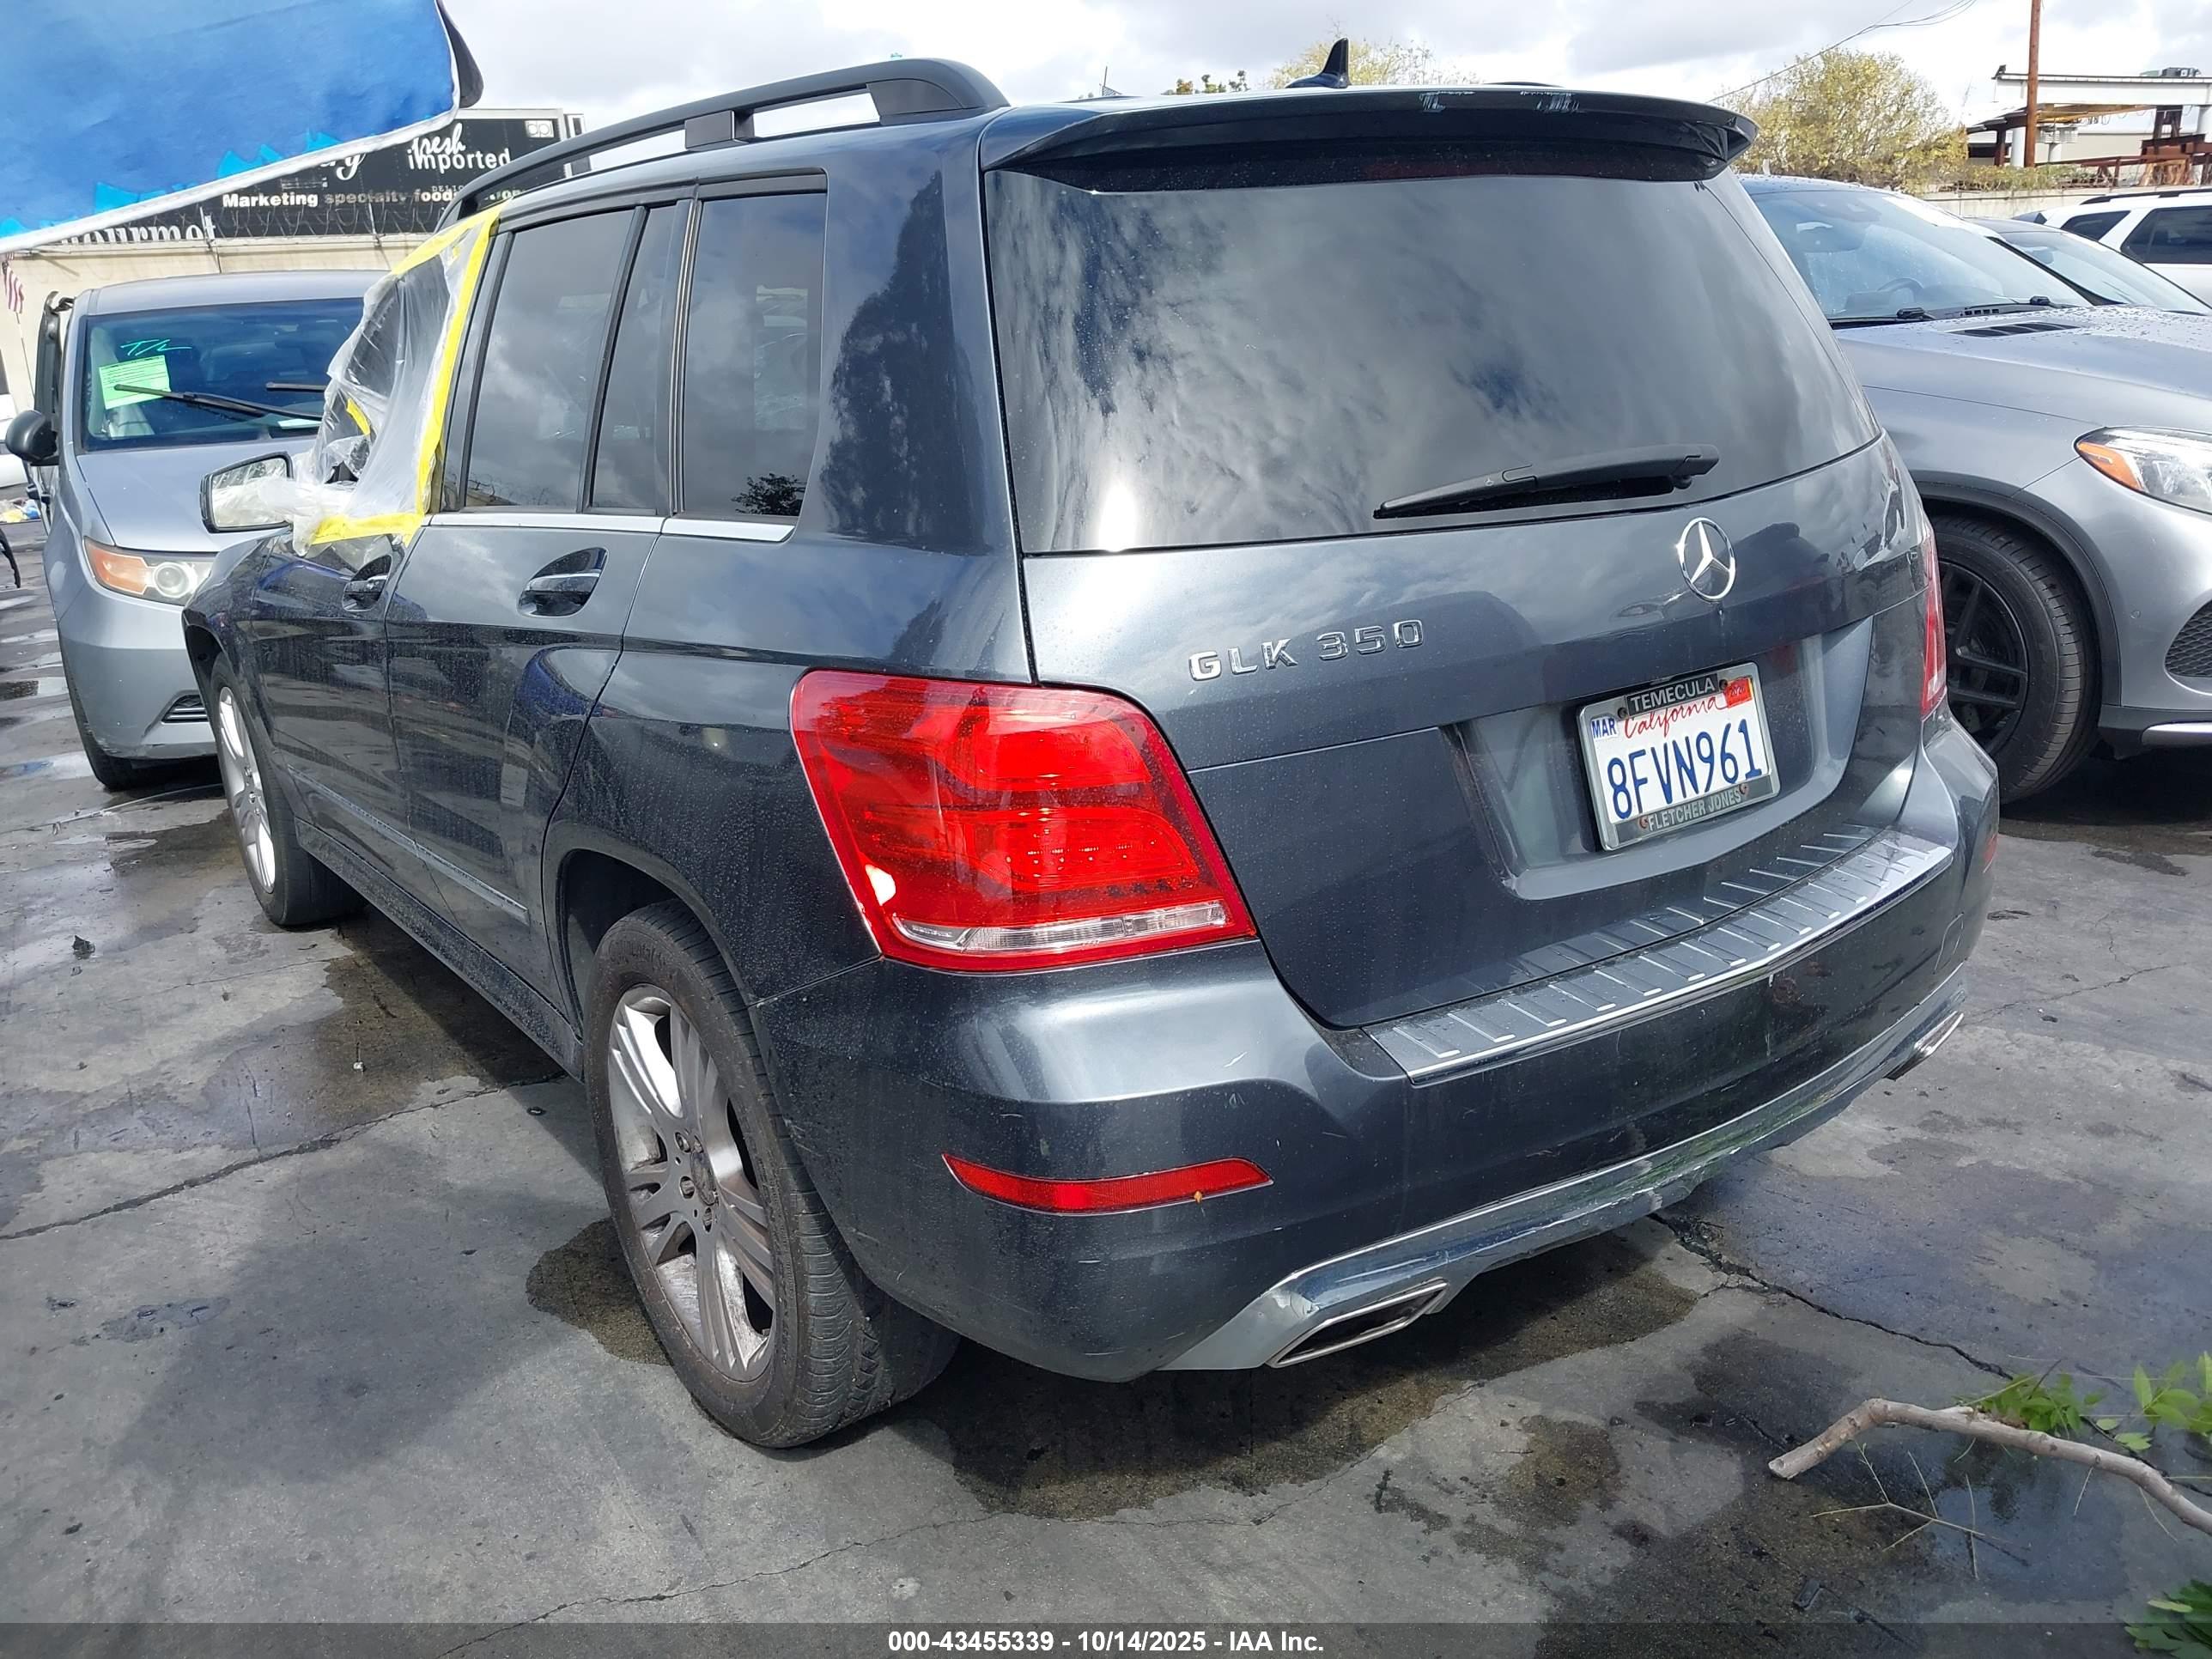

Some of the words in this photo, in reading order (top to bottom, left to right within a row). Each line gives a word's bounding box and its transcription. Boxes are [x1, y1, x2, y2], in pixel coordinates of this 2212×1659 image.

[407, 147, 511, 174] imported
[222, 191, 319, 208] Marketing
[414, 188, 457, 203] food
[1188, 638, 1299, 682] GLK
[1316, 619, 1424, 661] 350
[1631, 678, 1716, 712] TEMECULA
[1592, 719, 1617, 738] MAR
[1624, 696, 1728, 738] California
[1607, 718, 1763, 819] 8FVN961
[1648, 803, 1706, 832] FLETCHER
[1708, 789, 1742, 816] JONES
